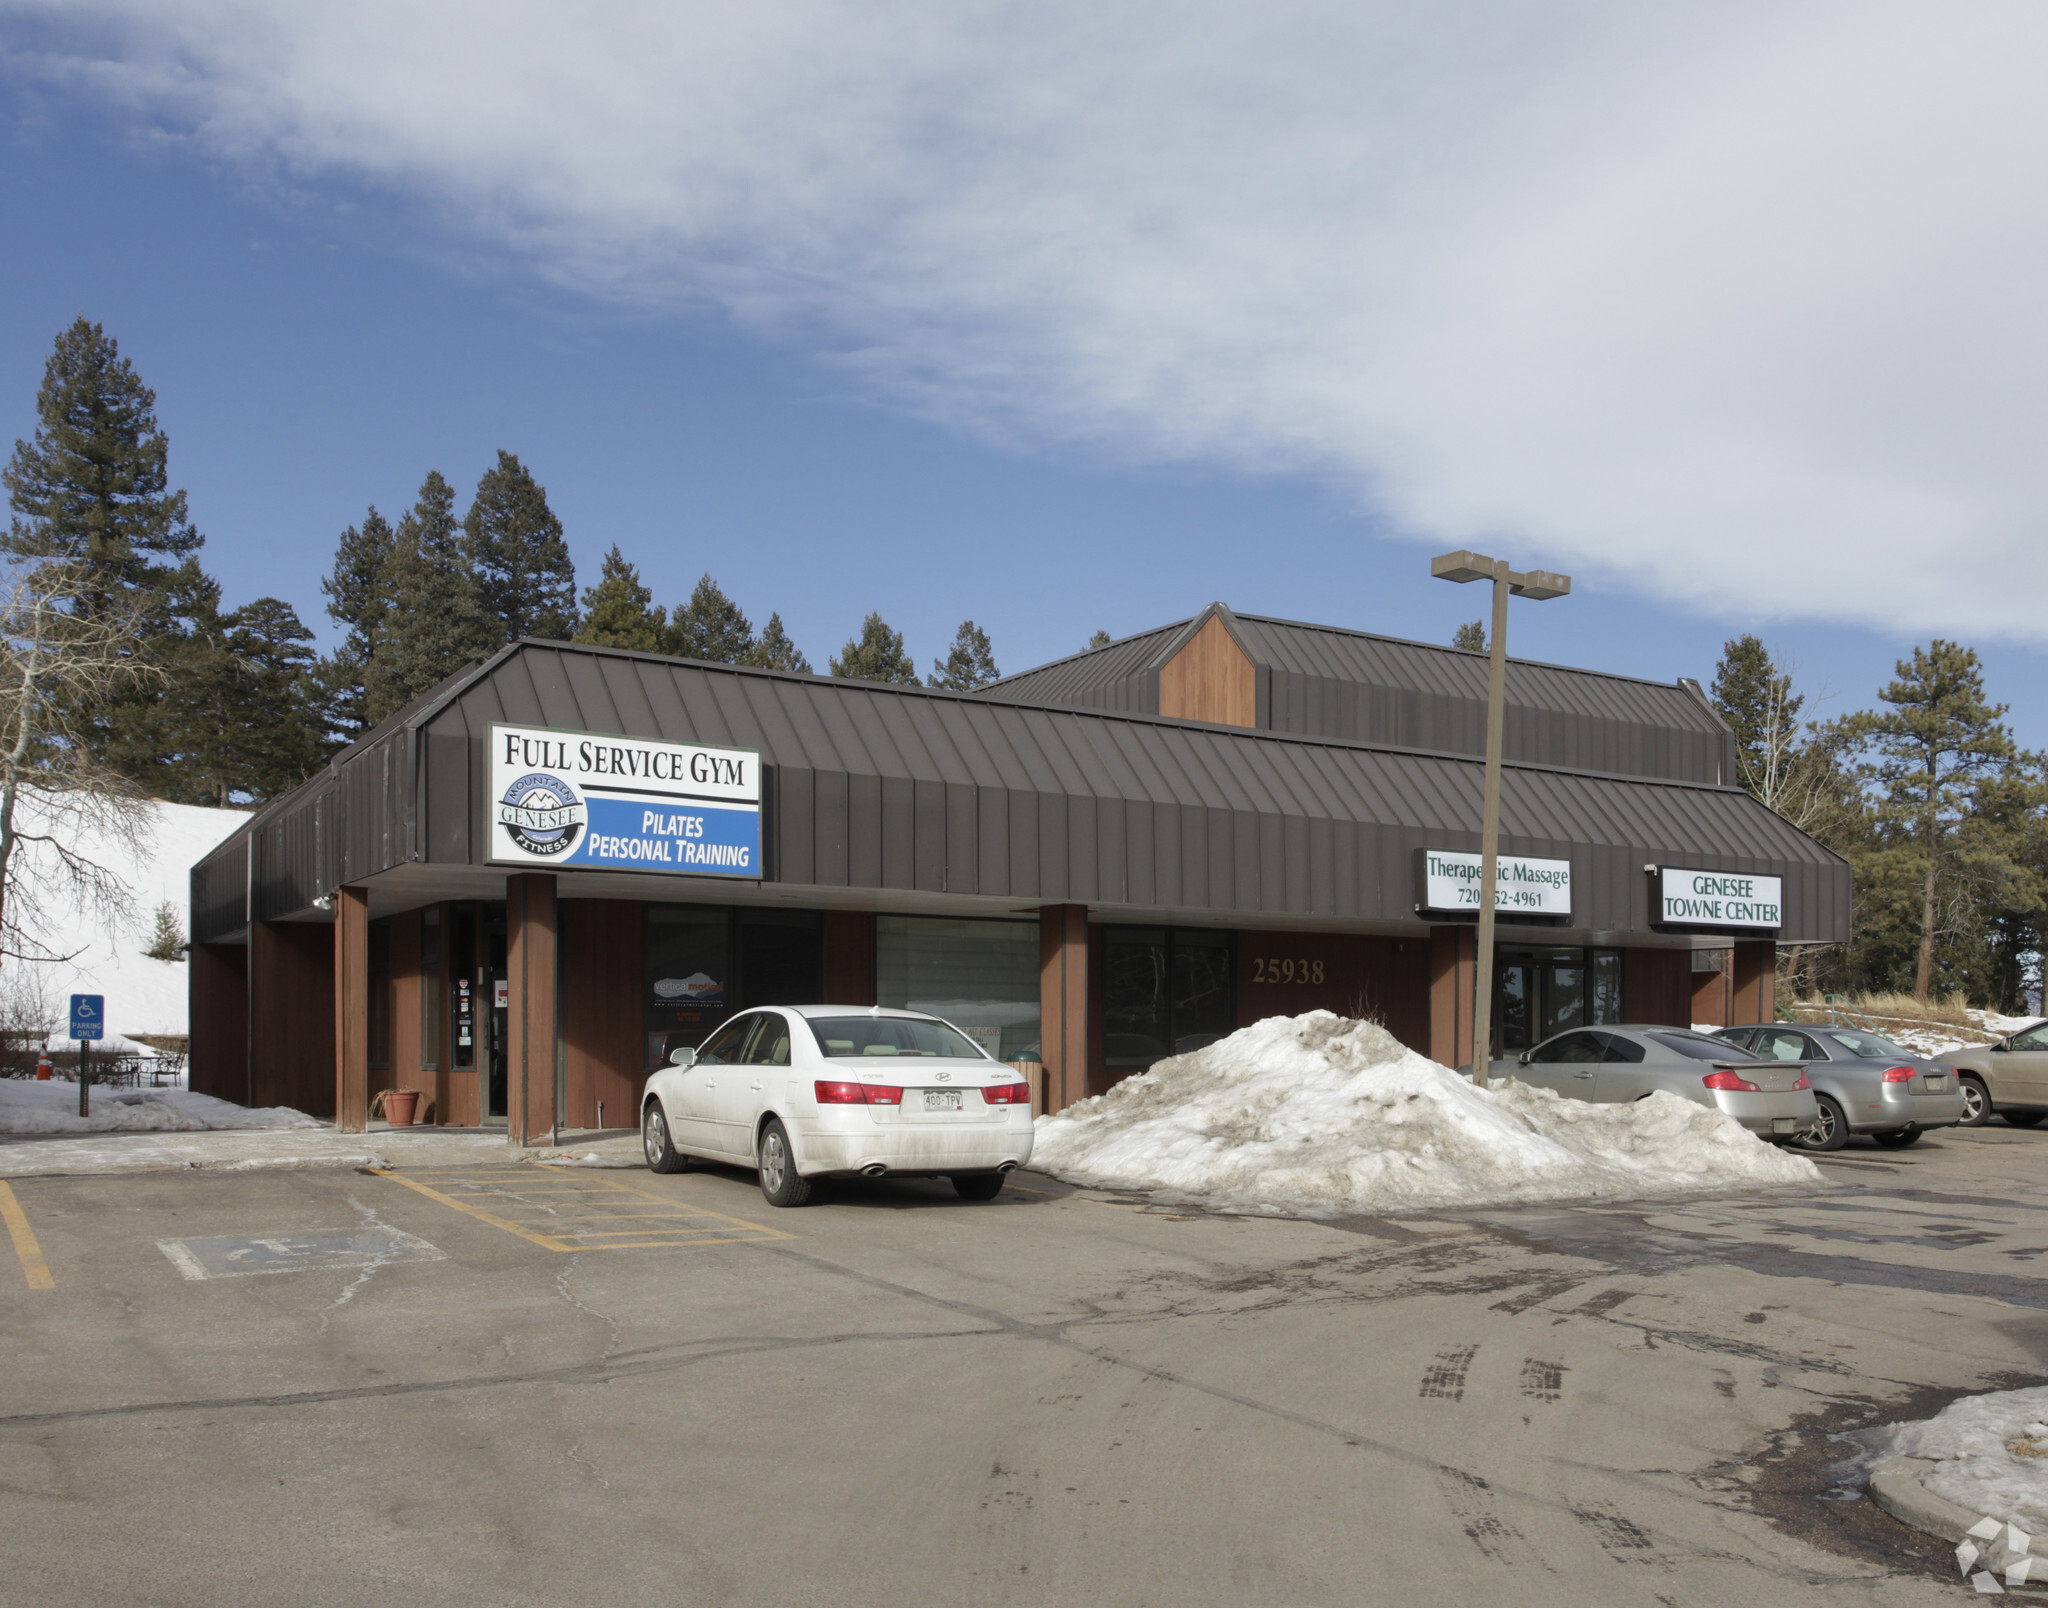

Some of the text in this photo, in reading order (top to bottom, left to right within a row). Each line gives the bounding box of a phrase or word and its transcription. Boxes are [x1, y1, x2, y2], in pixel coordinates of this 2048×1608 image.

[504, 733, 745, 786] FULL SERVICE GYM
[509, 777, 574, 802] MOUNTAIN
[501, 806, 577, 829] GENESEE
[642, 810, 704, 838] PILATES
[516, 834, 568, 853] FITNESS
[588, 833, 749, 867] PERSONAL TRAINING
[1428, 857, 1569, 889] Therapeic Massage
[1693, 876, 1753, 898] GENESEE
[1664, 897, 1779, 922] TOWNE CENTER
[1252, 958, 1325, 985] 25938
